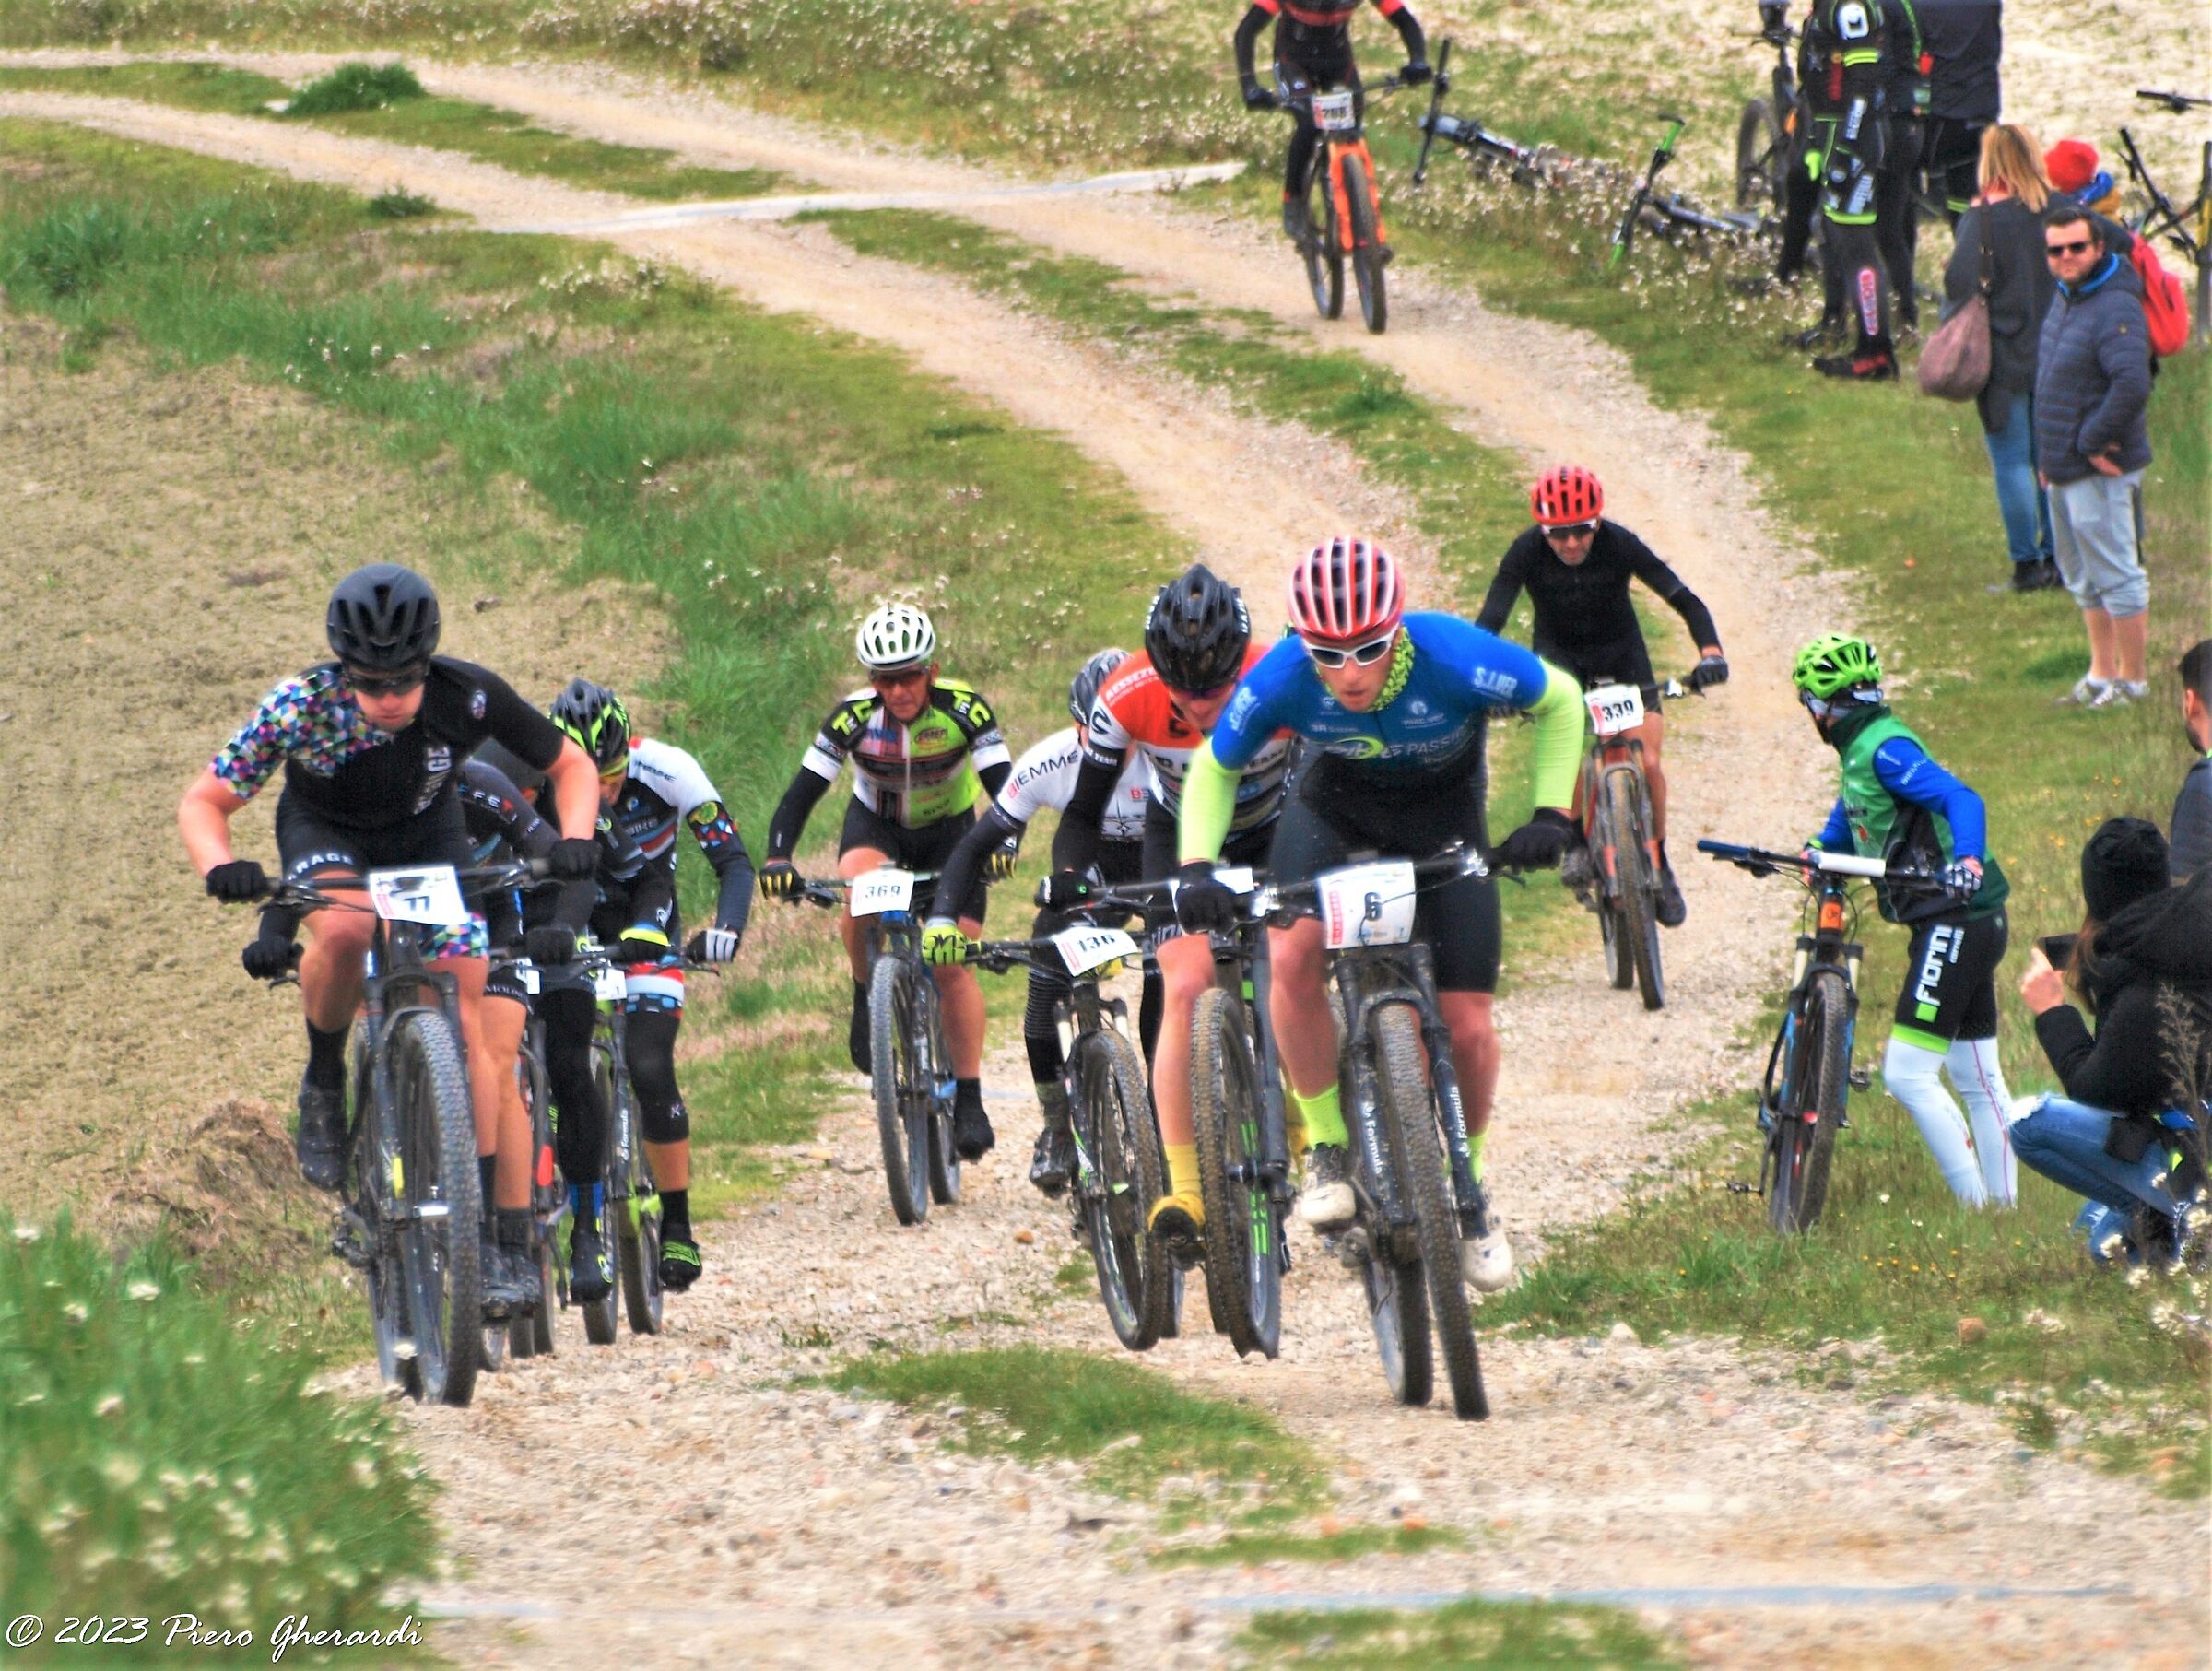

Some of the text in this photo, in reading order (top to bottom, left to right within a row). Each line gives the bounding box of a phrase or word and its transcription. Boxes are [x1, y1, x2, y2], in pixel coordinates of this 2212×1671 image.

[1602, 700, 1634, 722] 339
[1006, 749, 1079, 799] BIEMME
[865, 885, 900, 899] 369
[1364, 891, 1382, 921] 6
[1077, 934, 1116, 953] 136
[1449, 1086, 1468, 1139] Formula
[1365, 1119, 1383, 1174] Formula
